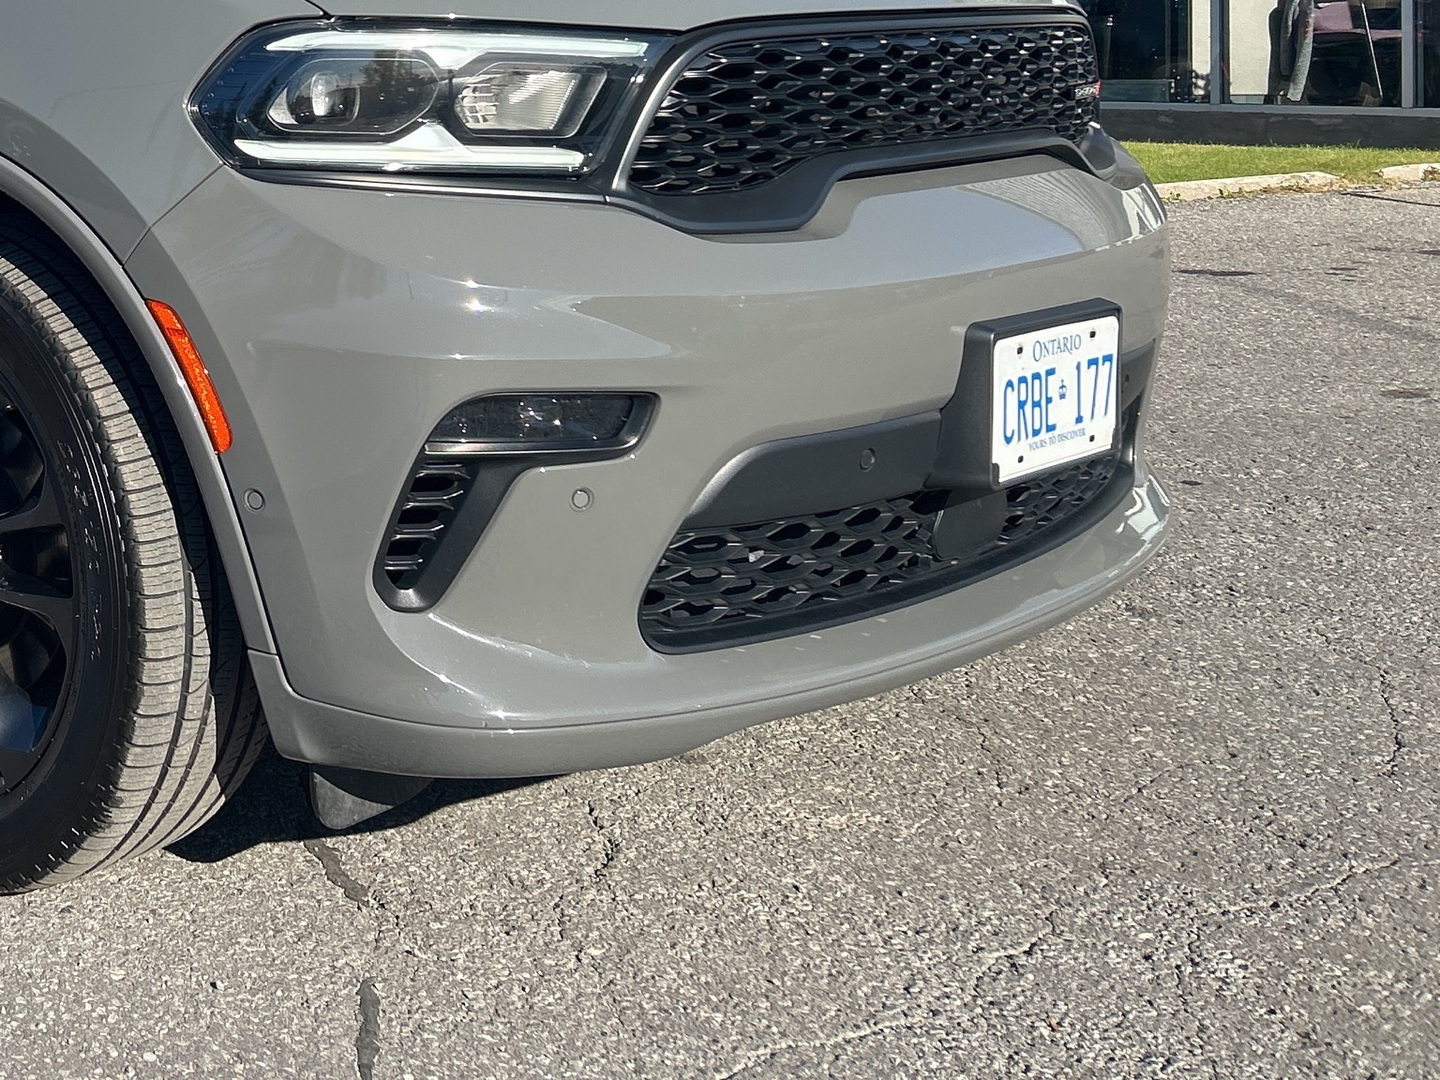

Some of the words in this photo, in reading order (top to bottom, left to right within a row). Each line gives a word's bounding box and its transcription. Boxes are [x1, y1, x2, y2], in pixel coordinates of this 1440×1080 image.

[1032, 334, 1082, 362] ONTARIO
[1002, 367, 1057, 445] CRBE
[1074, 353, 1114, 425] 177
[1028, 437, 1047, 452] YOURS
[1048, 434, 1057, 446] TO
[1057, 427, 1087, 443] DISCOVER
